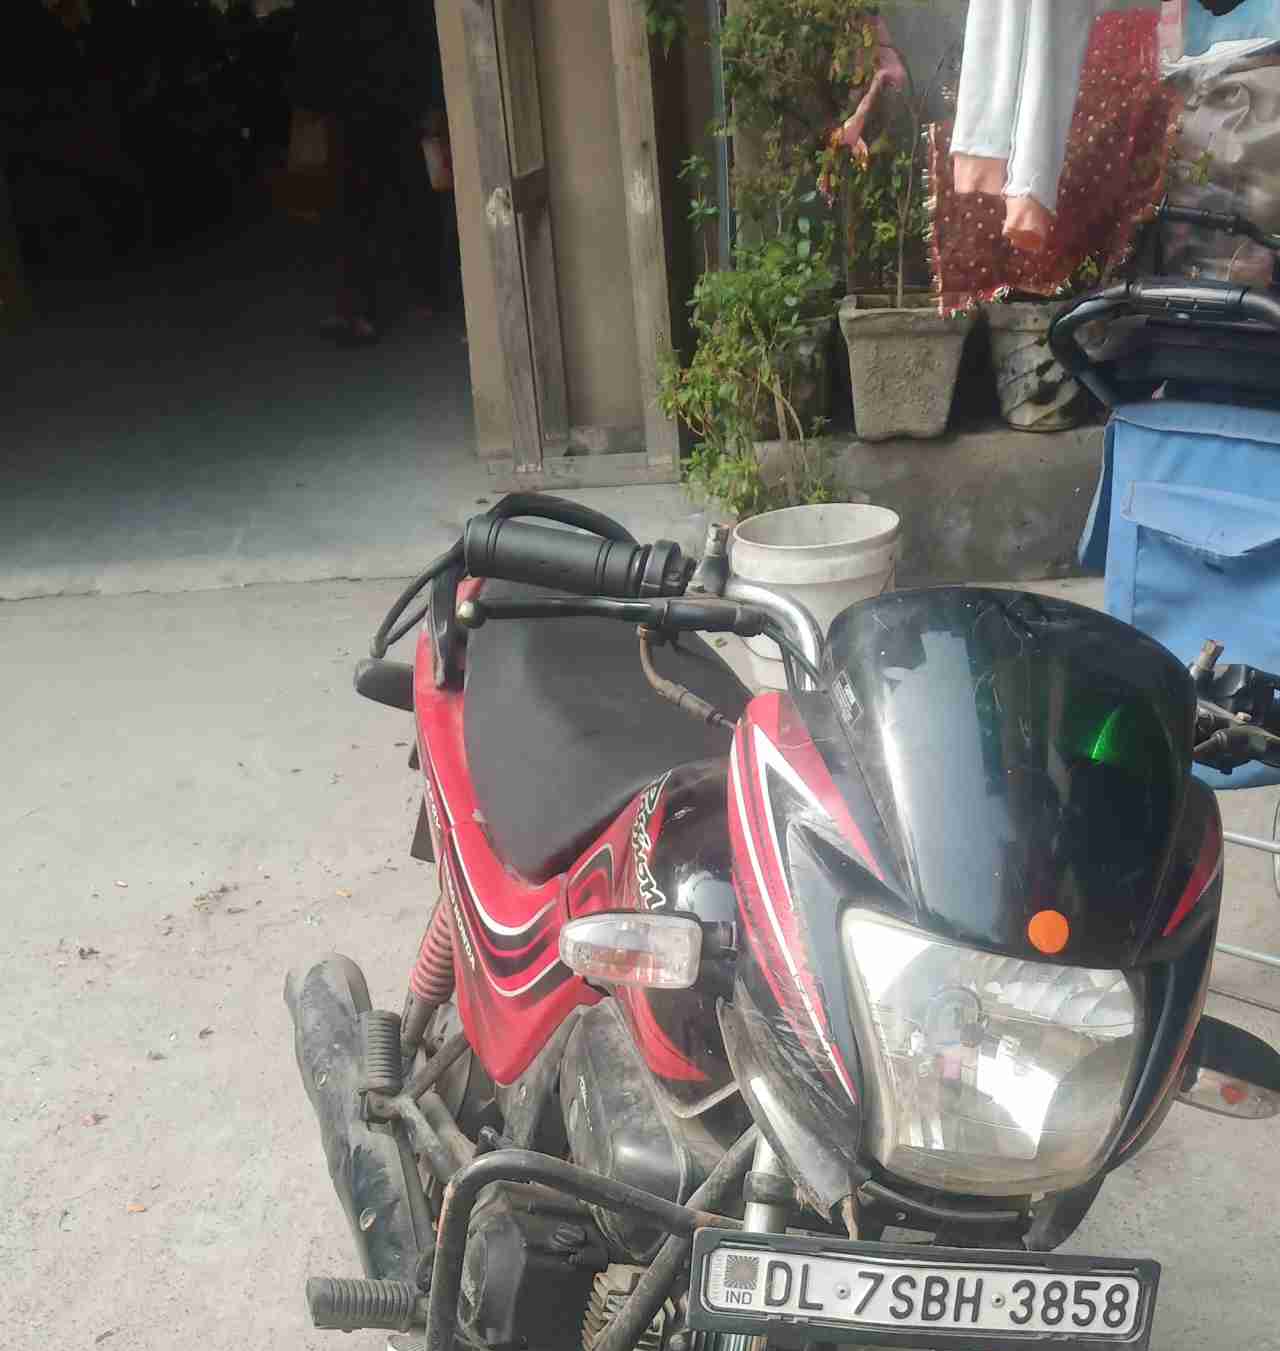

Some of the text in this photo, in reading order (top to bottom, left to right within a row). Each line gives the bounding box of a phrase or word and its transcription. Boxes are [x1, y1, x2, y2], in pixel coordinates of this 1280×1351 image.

[726, 1290, 752, 1304] IND
[765, 1260, 823, 1311] DL
[854, 1271, 983, 1322] 7SBH
[1009, 1280, 1130, 1328] 3858
